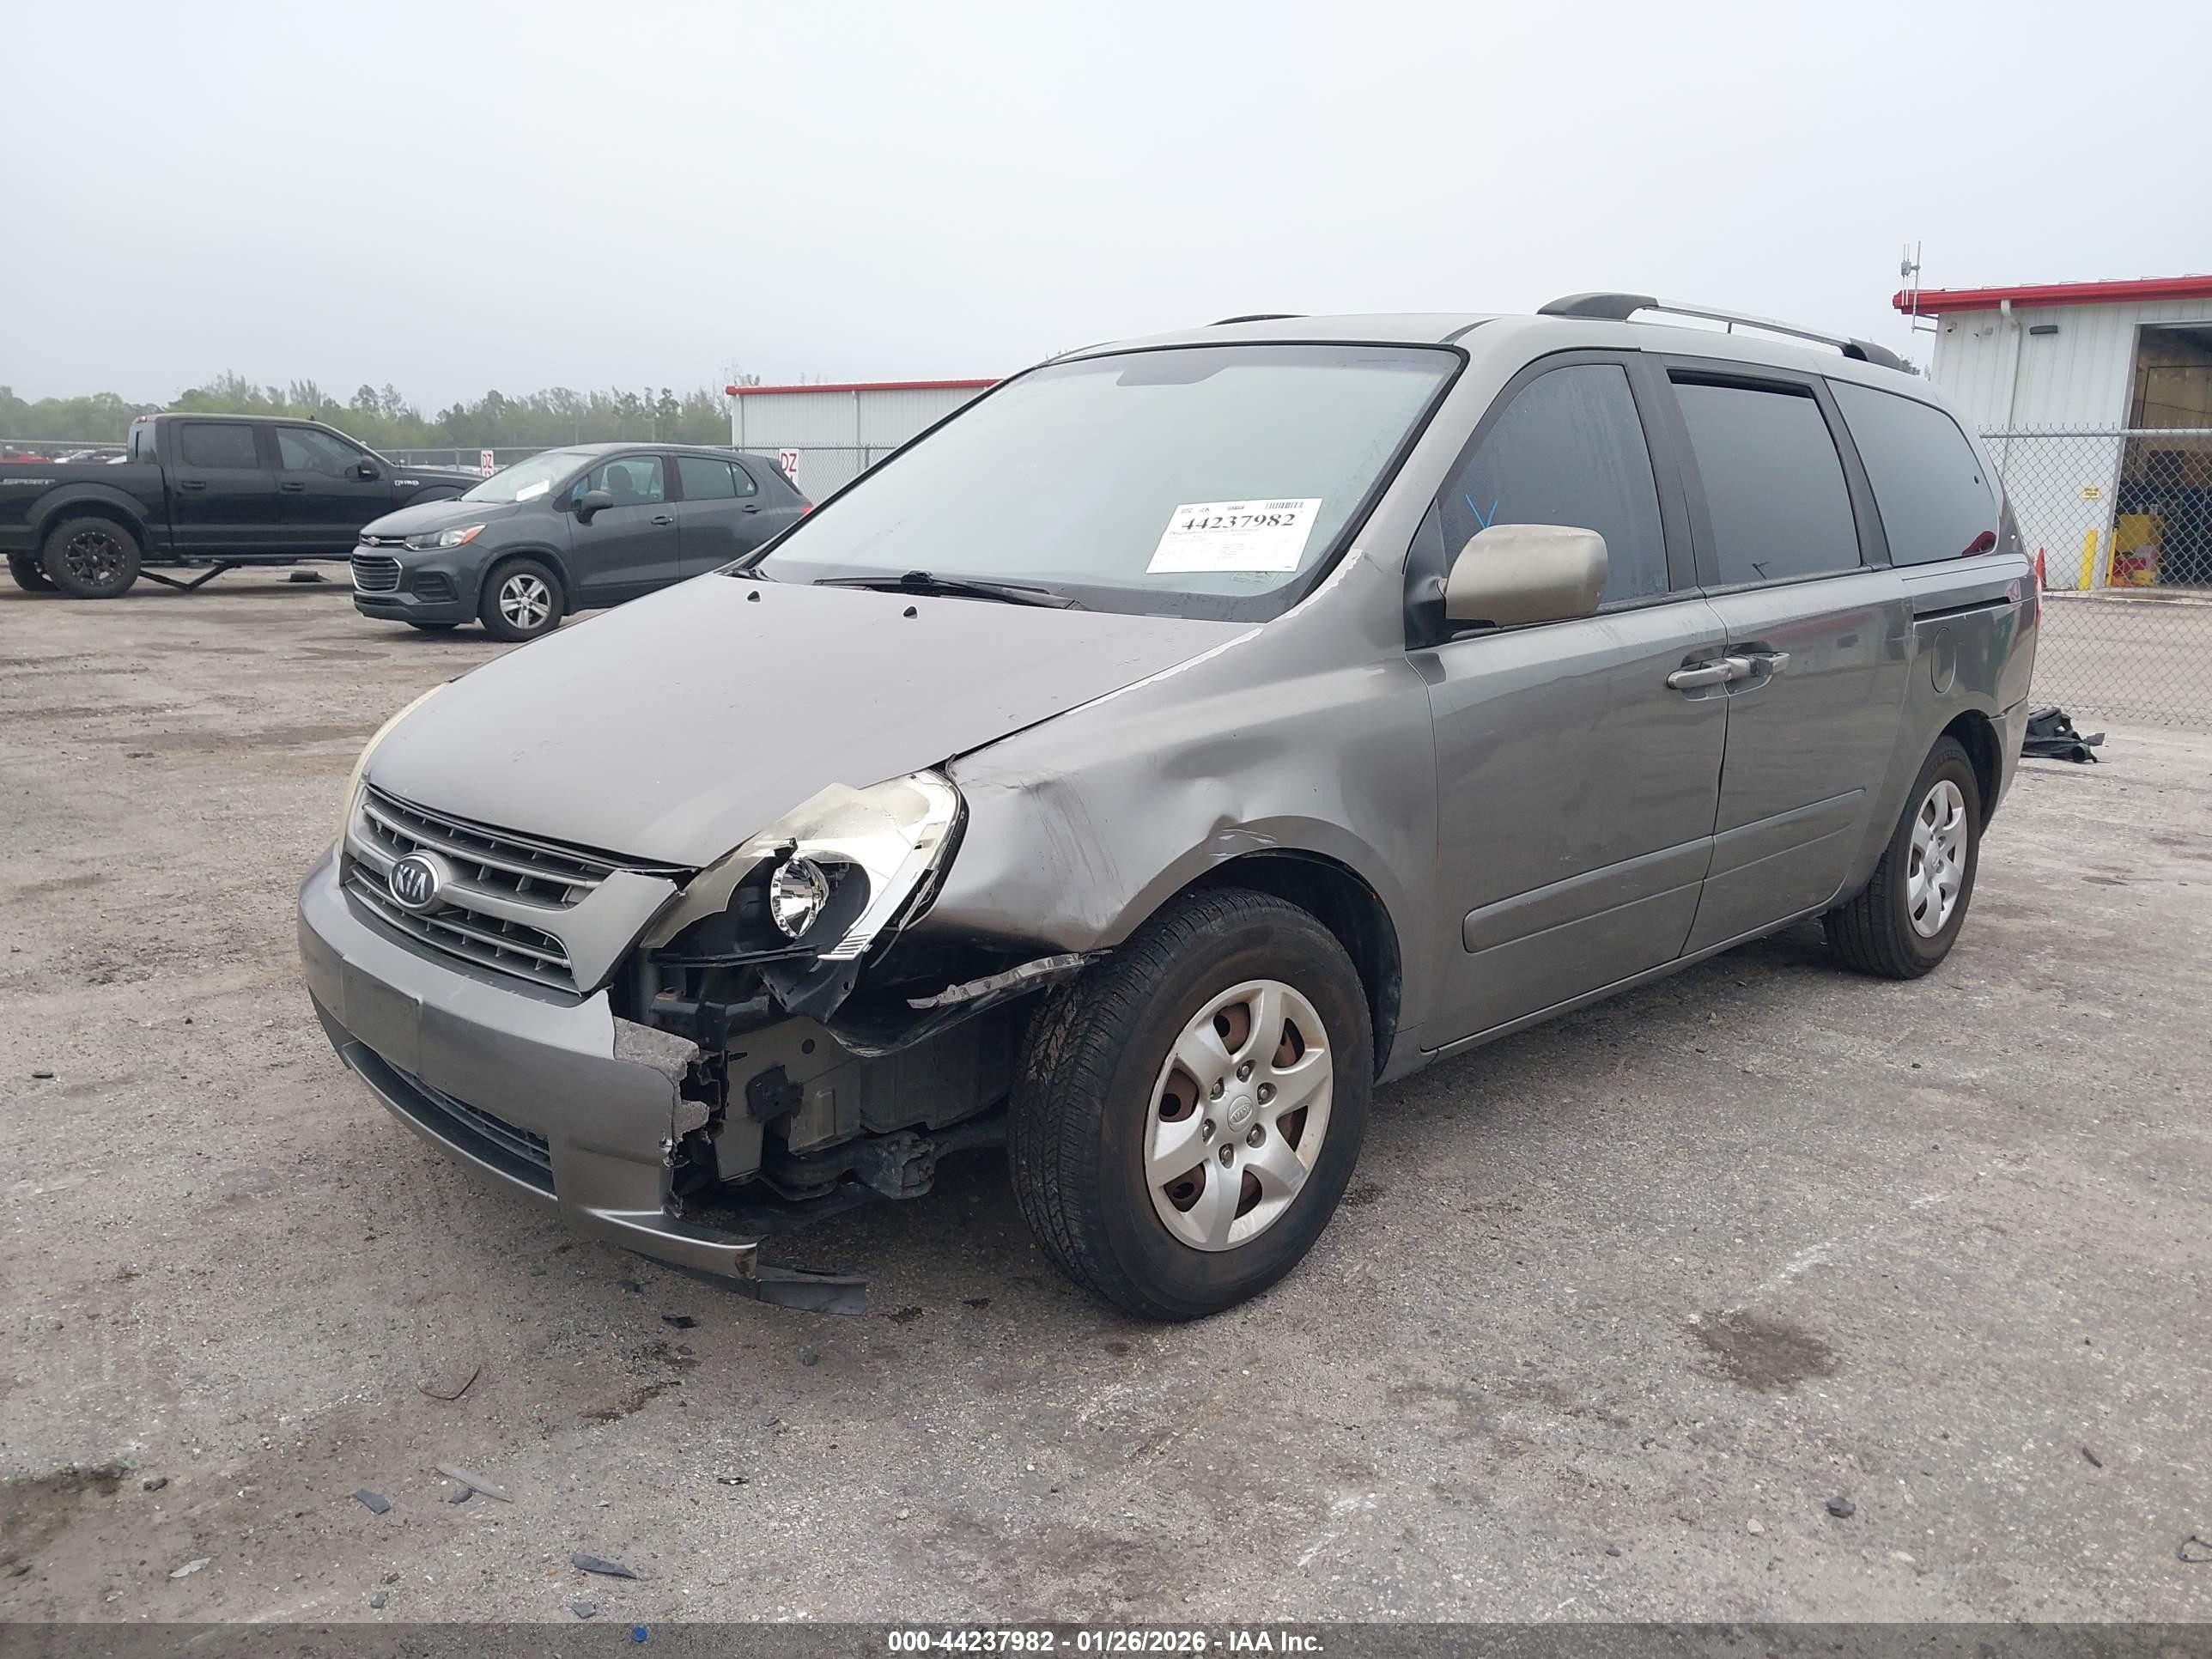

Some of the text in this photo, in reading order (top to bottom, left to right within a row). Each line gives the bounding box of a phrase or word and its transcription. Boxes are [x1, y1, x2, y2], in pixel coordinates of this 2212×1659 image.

[482, 453, 493, 469] DZ
[781, 453, 797, 472] DZ
[1181, 514, 1296, 530] 44237982
